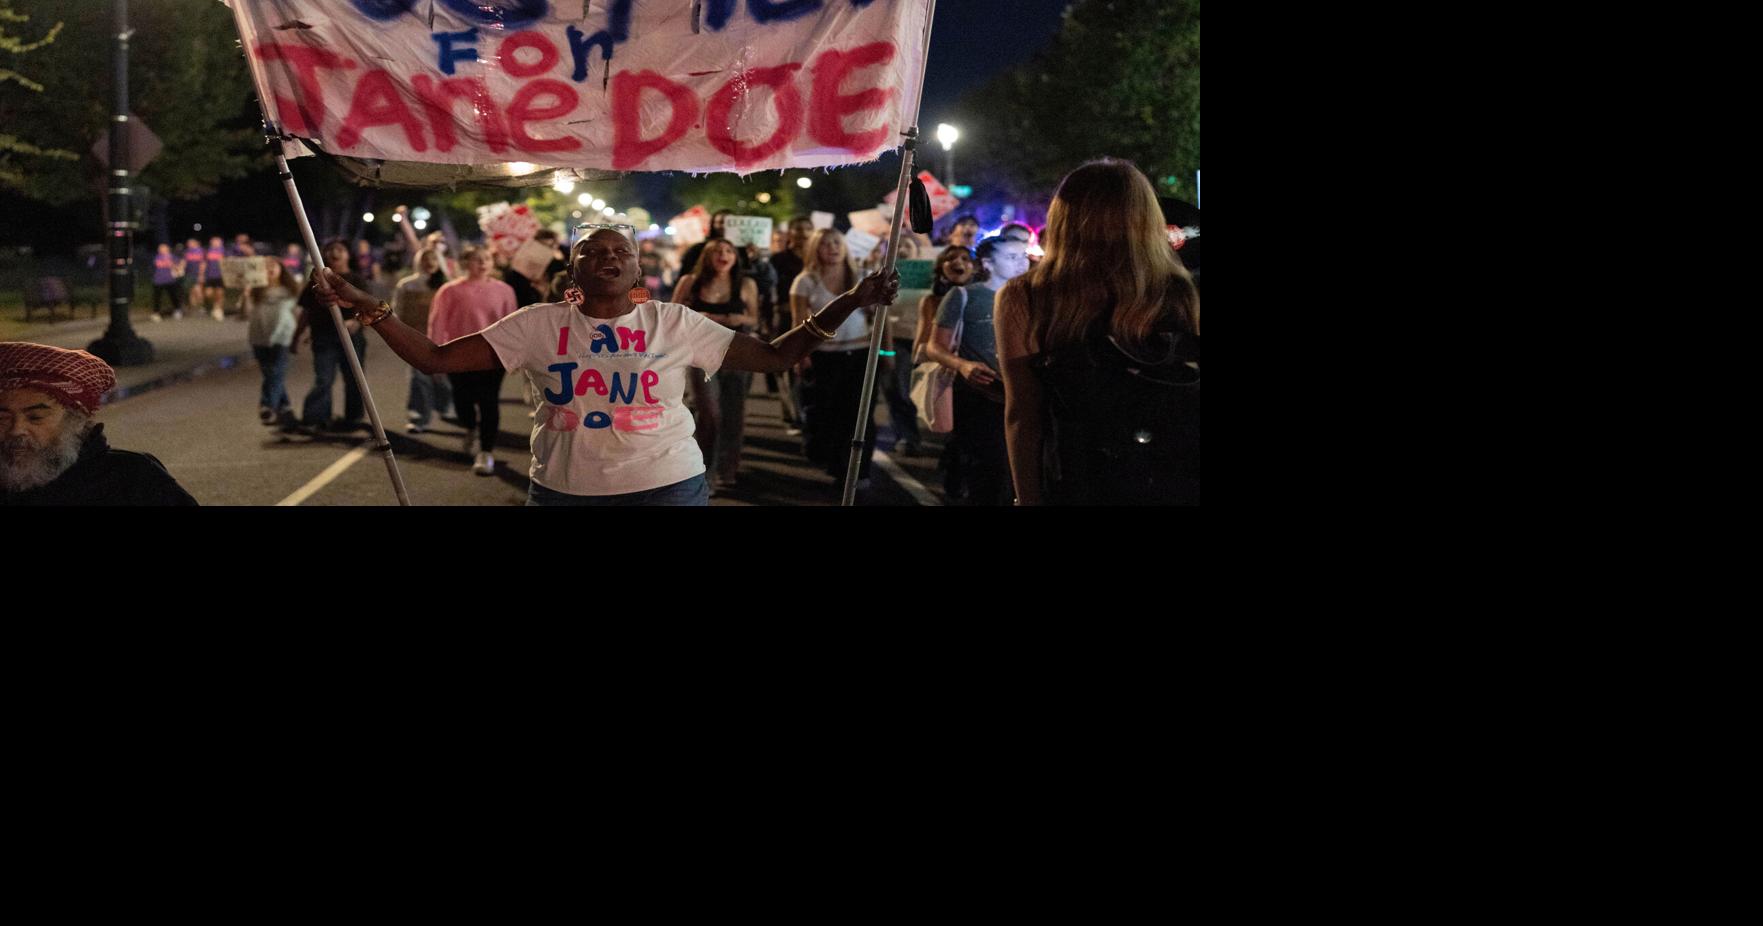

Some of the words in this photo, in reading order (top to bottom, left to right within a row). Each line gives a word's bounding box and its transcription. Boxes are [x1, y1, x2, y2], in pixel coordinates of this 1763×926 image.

[611, 41, 897, 169] DOE
[557, 326, 570, 355] I
[589, 324, 647, 353] AM
